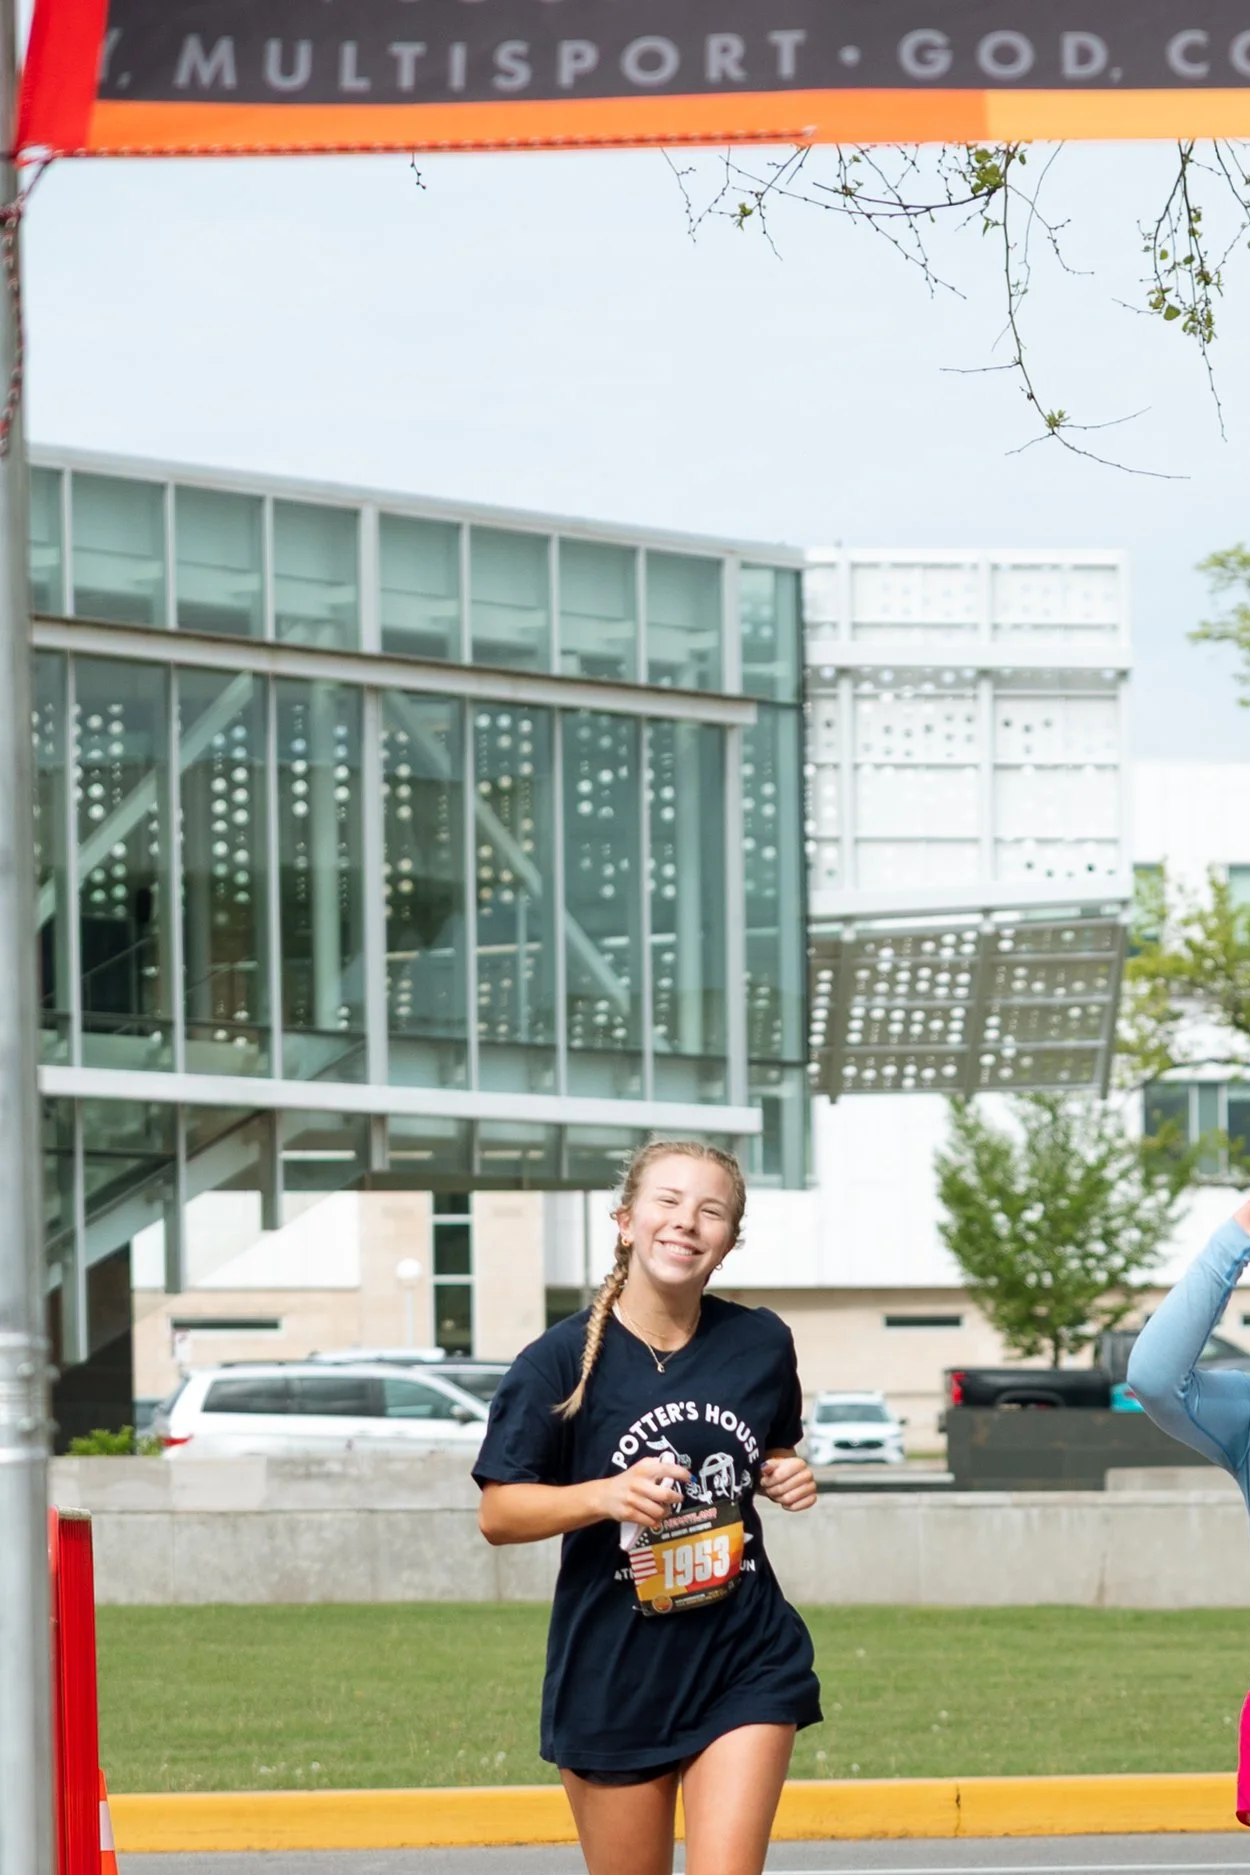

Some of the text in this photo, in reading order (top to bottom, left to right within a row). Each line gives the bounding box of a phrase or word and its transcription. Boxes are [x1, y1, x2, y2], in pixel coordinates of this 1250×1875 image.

[174, 29, 807, 92] MULTISPORT
[611, 1401, 760, 1470] POTTER'S HOUSE
[661, 1535, 730, 1590] 1953
